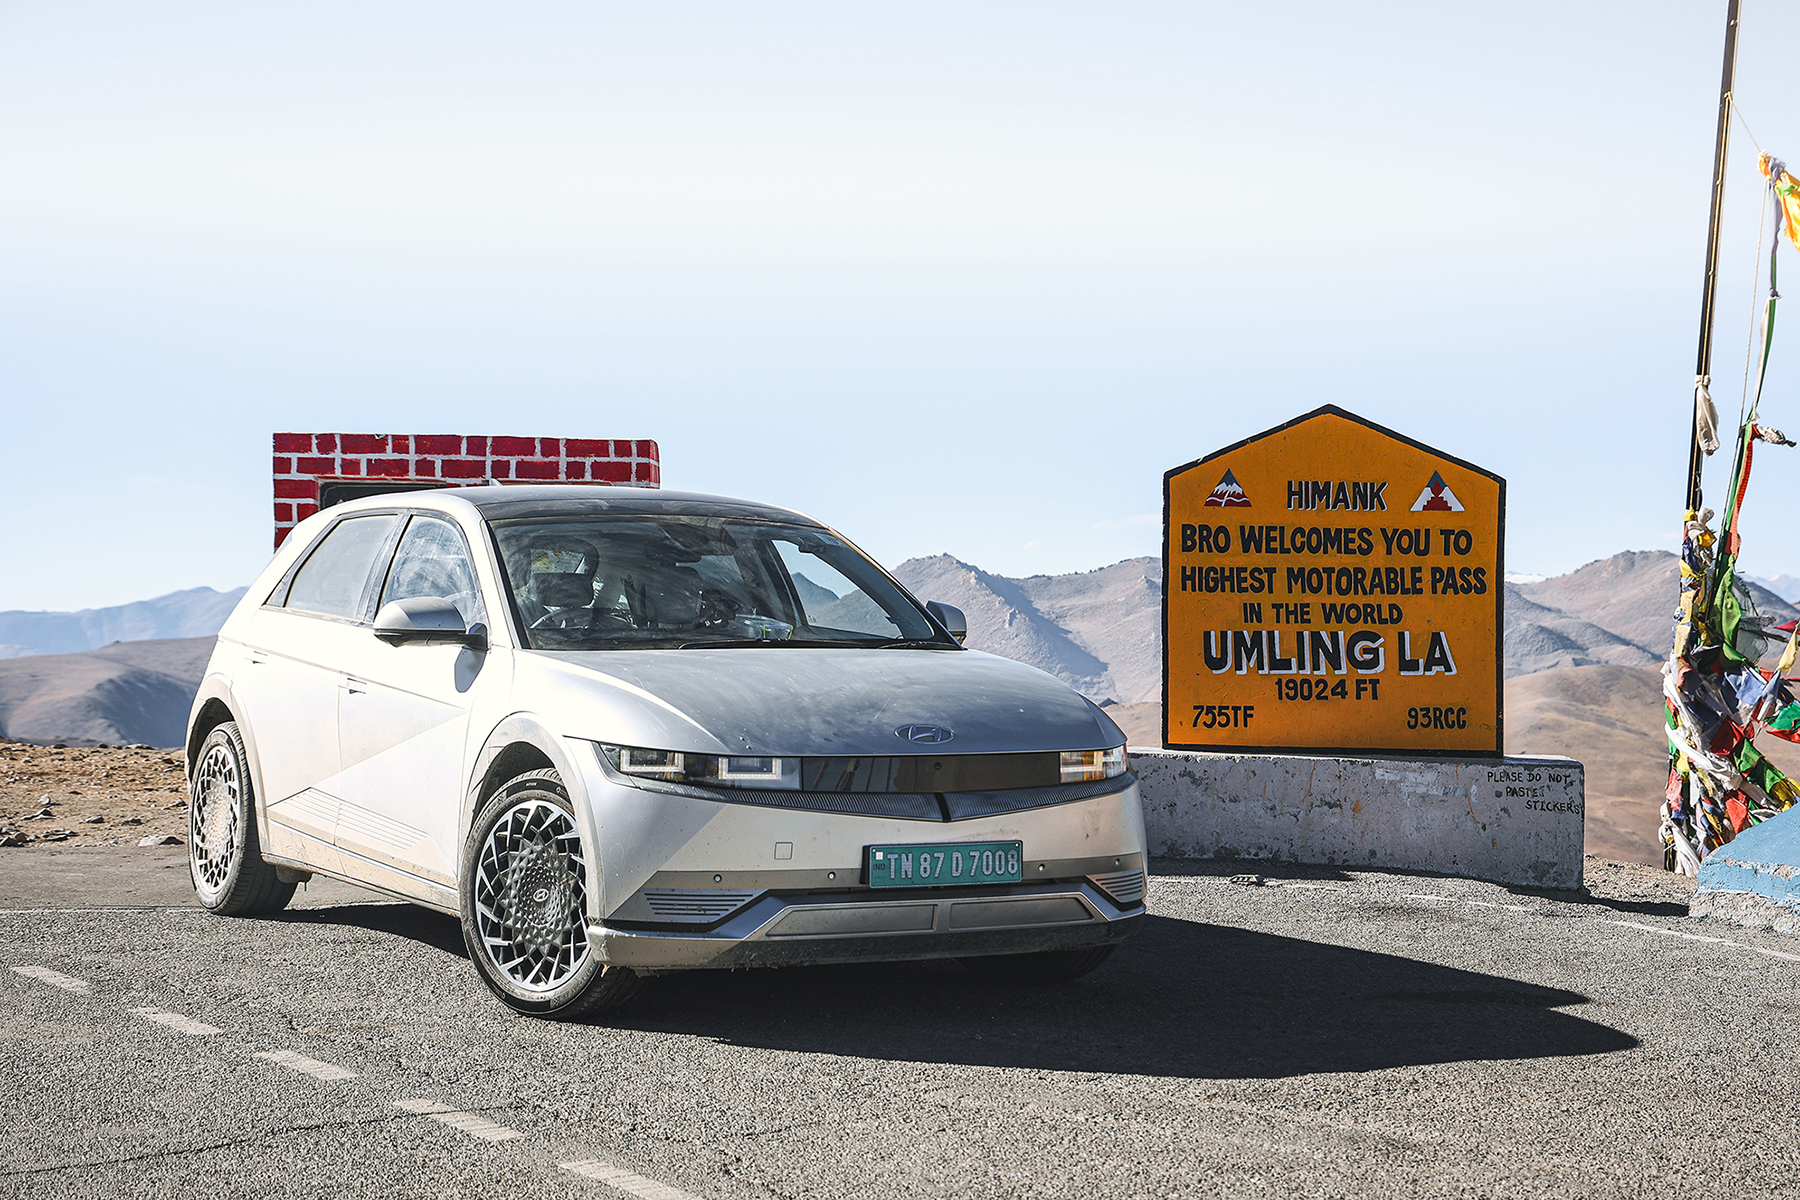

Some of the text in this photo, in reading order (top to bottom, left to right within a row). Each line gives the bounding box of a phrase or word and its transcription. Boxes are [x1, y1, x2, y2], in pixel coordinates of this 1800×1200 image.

[1286, 480, 1388, 511] HIMANK
[1181, 524, 1473, 556] BRO WELCOMES YOU TO
[1180, 566, 1488, 596] HIGHEST MOTORABLE PASS
[1243, 602, 1404, 625] IN THE WORLD
[1203, 630, 1458, 676] UMLING LA
[1274, 678, 1381, 701] 19024 FT
[1192, 705, 1255, 728] 755TF
[1406, 706, 1468, 730] 93RCC
[1487, 771, 1571, 784] PLEASE DO NOT
[1505, 786, 1540, 798] PASTE
[1525, 801, 1581, 814] STICKERS
[873, 862, 886, 871] IND
[887, 849, 1018, 879] TN 87 D 7008
